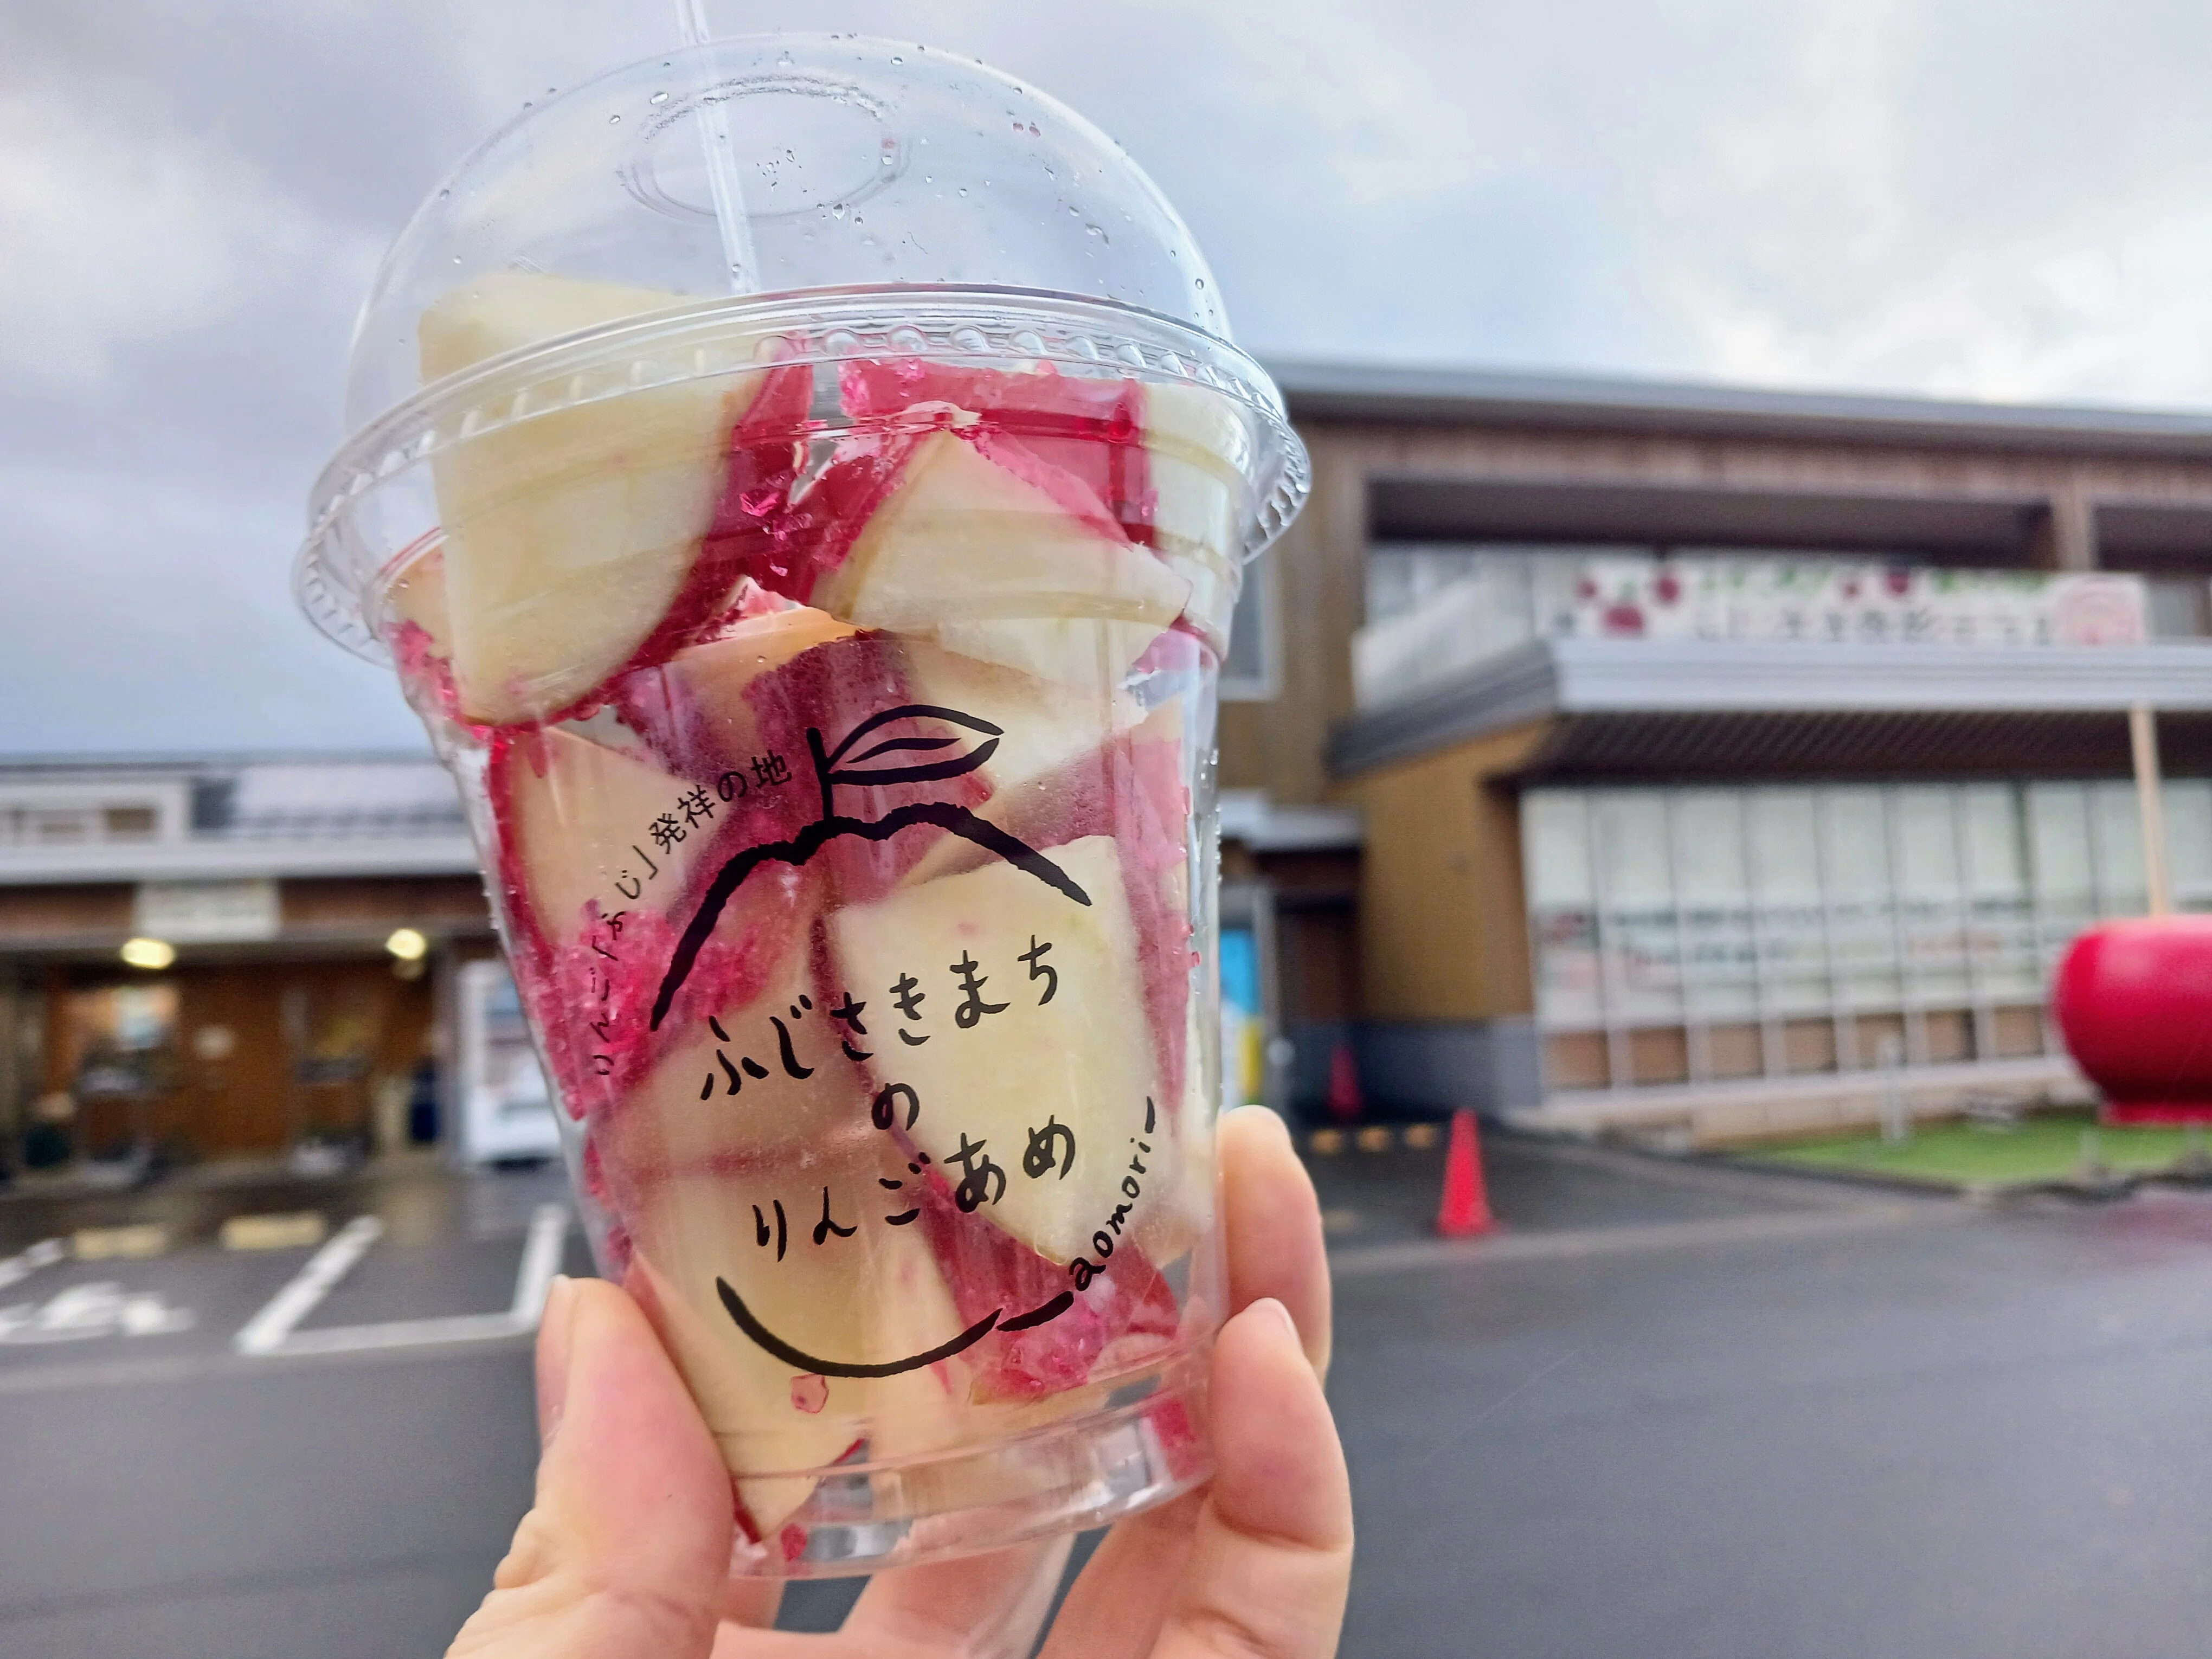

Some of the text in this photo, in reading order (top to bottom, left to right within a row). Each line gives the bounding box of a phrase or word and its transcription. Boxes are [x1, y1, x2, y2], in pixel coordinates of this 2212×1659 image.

[700, 935, 1058, 1101] ふじさきまち
[872, 1083, 919, 1130] の
[753, 1115, 1075, 1262] りんごあめ
[1069, 1137, 1152, 1291] aomori
